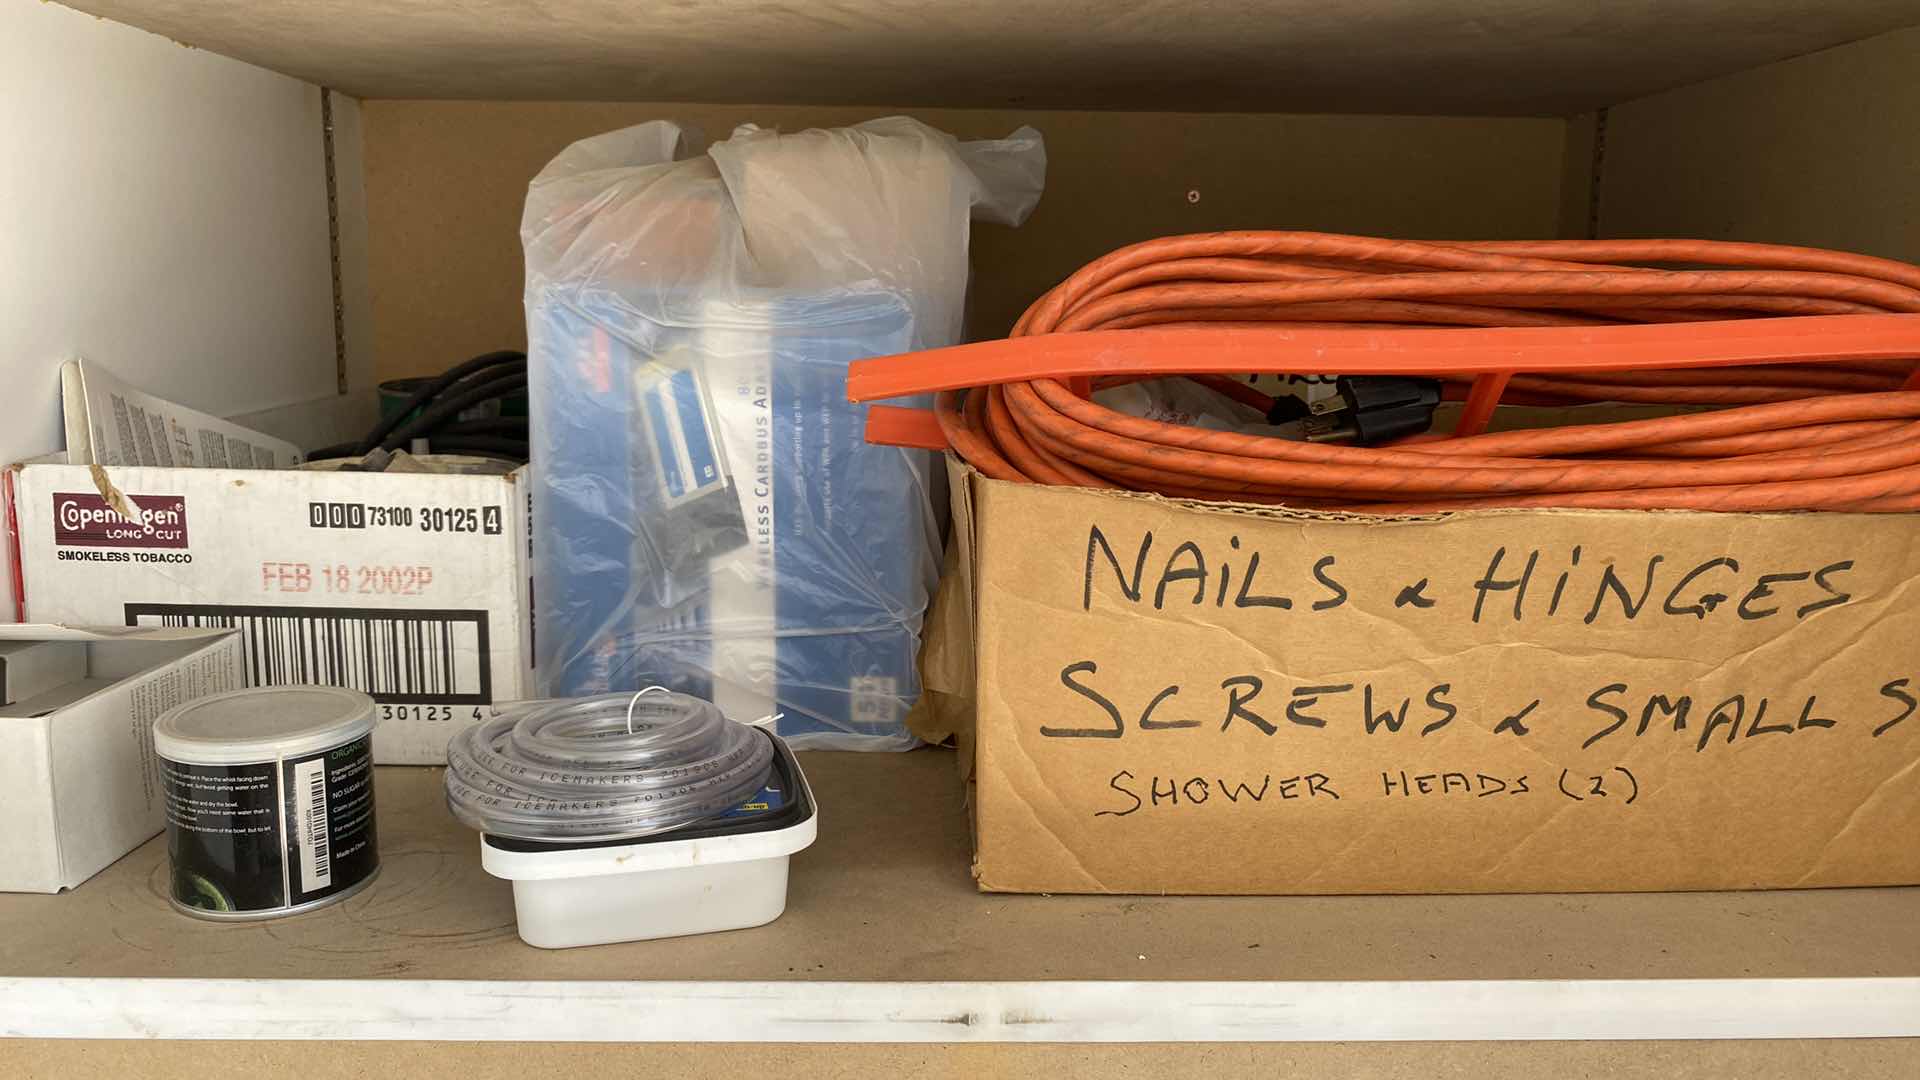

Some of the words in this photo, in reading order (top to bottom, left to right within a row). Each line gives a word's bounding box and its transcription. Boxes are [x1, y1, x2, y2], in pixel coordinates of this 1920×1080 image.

[754, 416, 769, 498] CARDBUS
[60, 500, 179, 535] Copengen
[368, 507, 412, 526] 73100
[420, 508, 477, 532] 30125
[483, 506, 502, 535] 4
[106, 529, 142, 539] LONG
[155, 530, 182, 540] CUT
[58, 551, 130, 561] SMOKELESS
[133, 553, 192, 563] TOBACCO
[262, 562, 311, 592] FEB
[322, 565, 349, 593] 18
[358, 566, 433, 595] 2002P
[383, 705, 453, 720] 30125
[472, 707, 483, 721] 4
[1039, 660, 1458, 739] SCREWS
[1581, 683, 1837, 753] SMALL
[502, 762, 527, 776] FOR
[540, 772, 645, 785] ICEMAKERS
[487, 780, 513, 796] FOR
[1095, 770, 1340, 817] SHOWER
[1383, 770, 1529, 799] HEADS
[1559, 766, 1638, 804] (2)
[477, 794, 501, 807] FOR
[513, 800, 618, 810] ICEMAKERS
